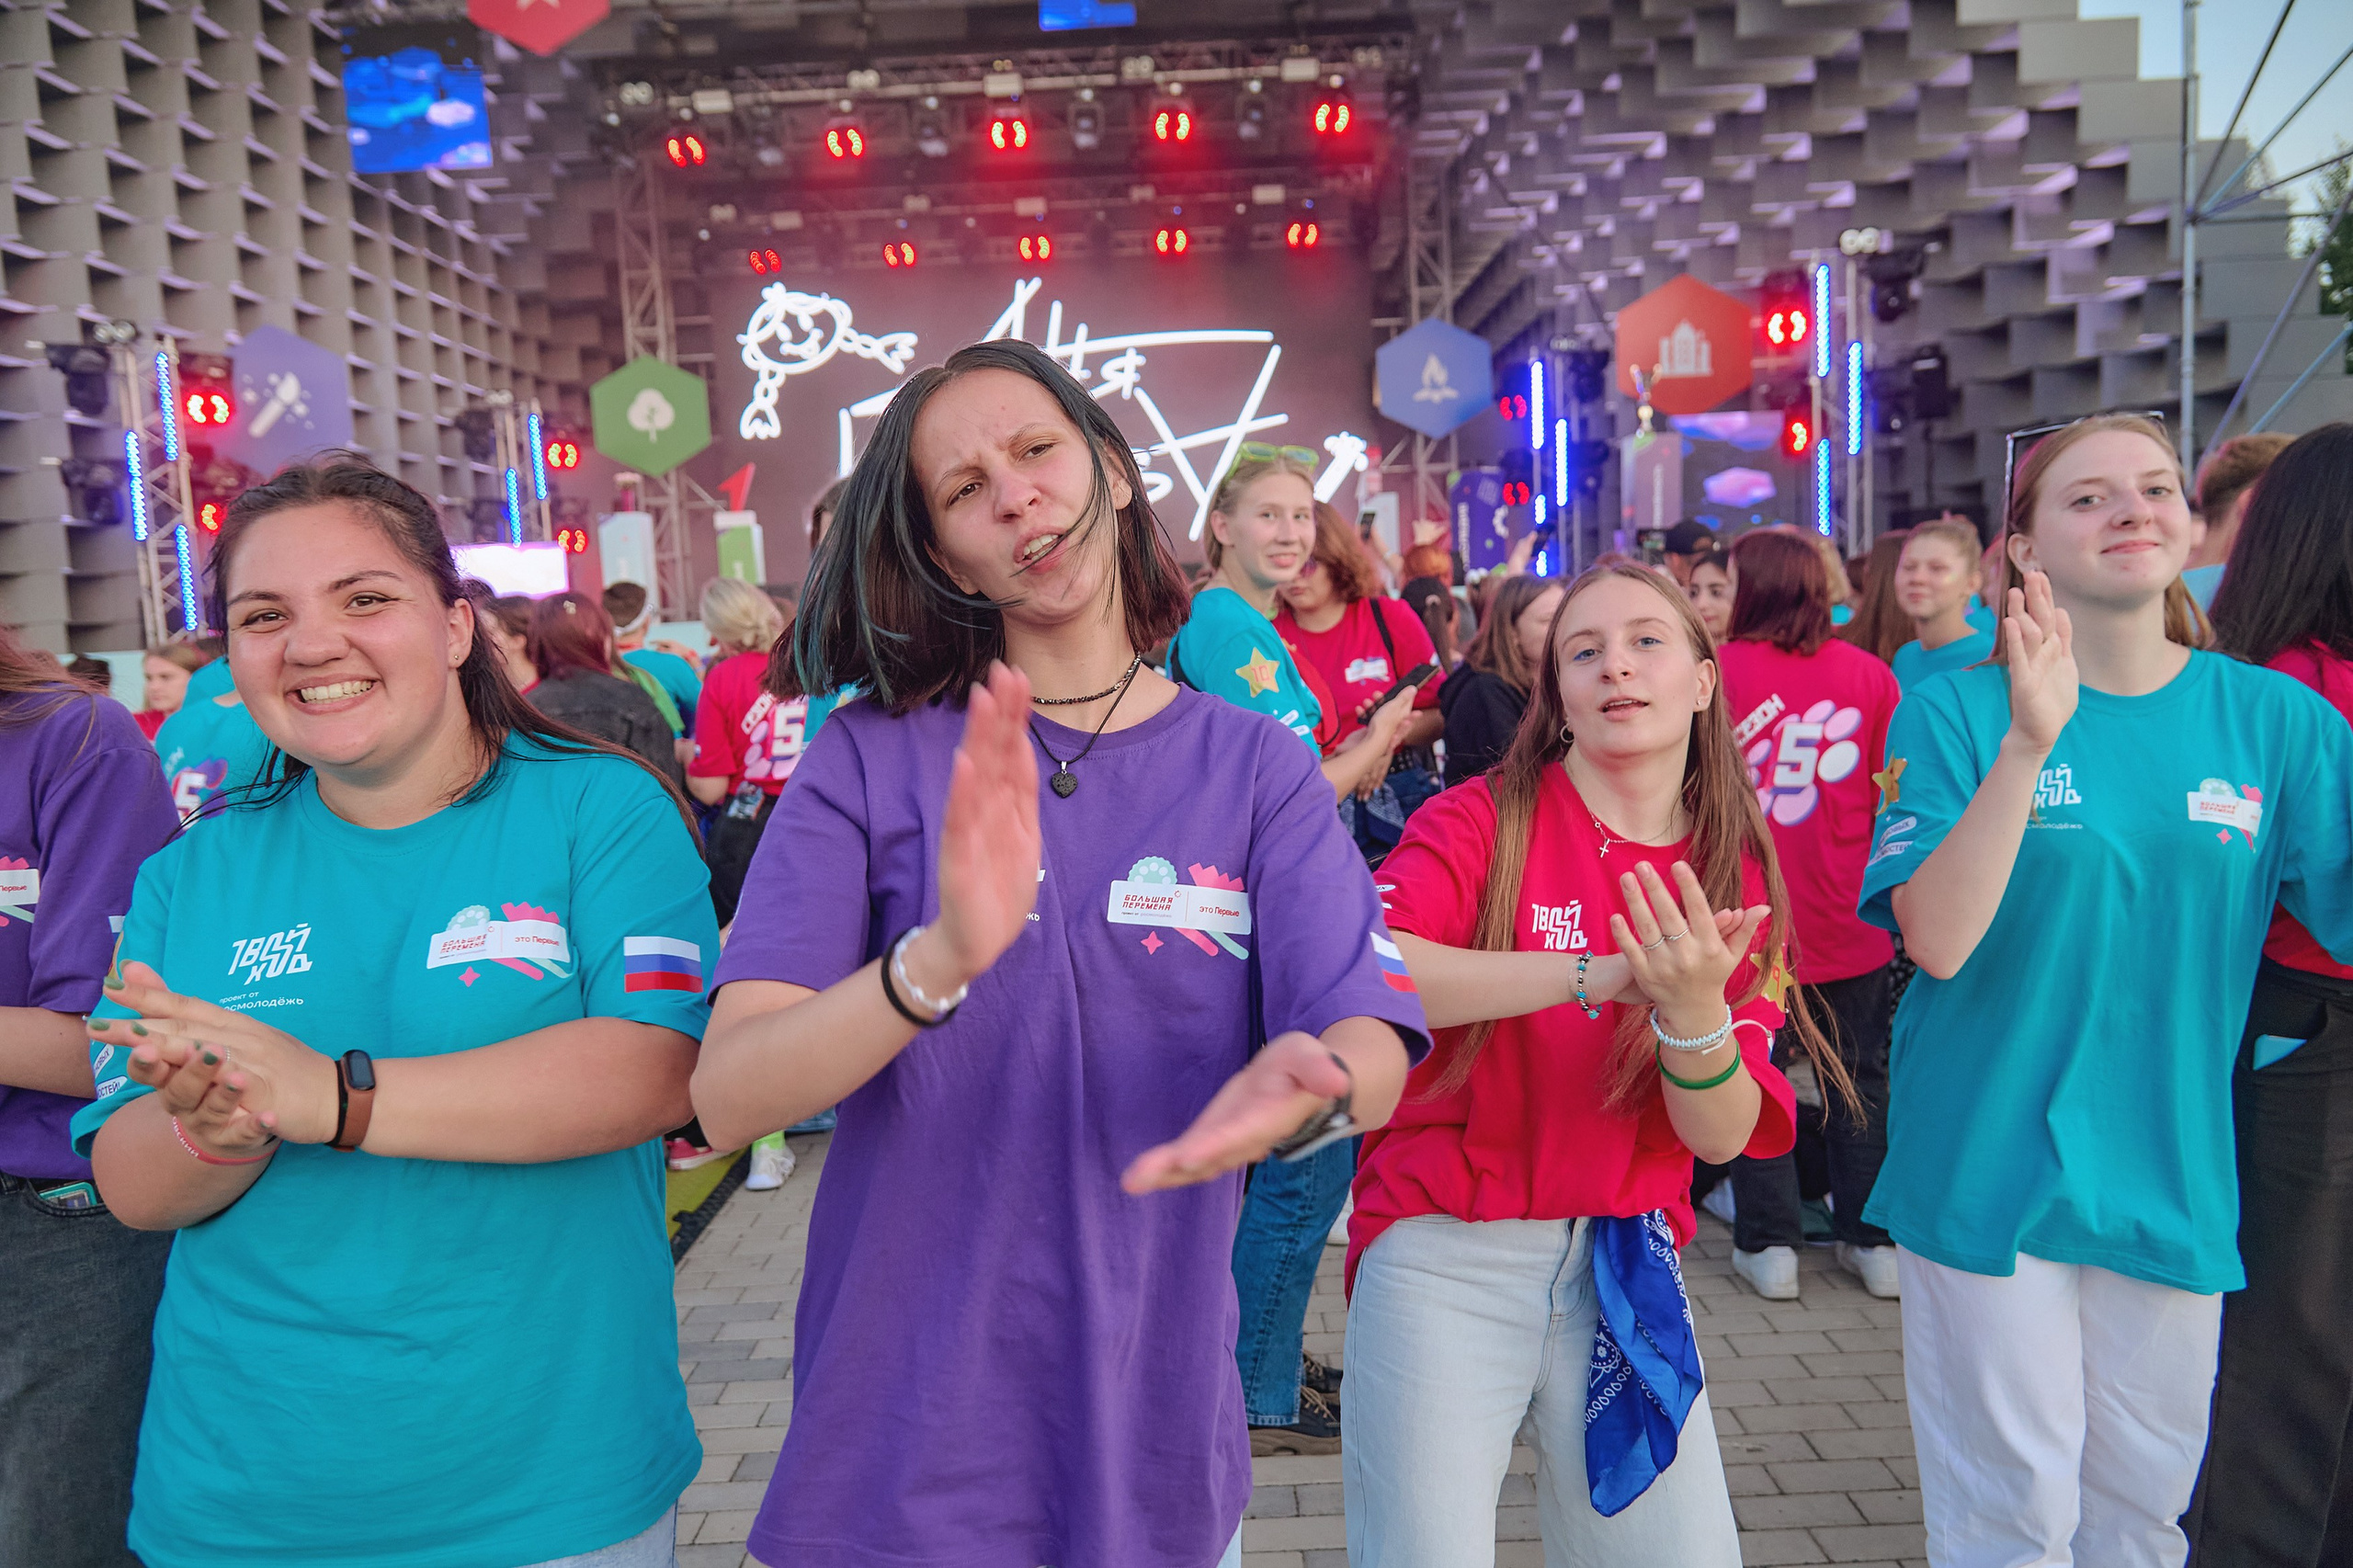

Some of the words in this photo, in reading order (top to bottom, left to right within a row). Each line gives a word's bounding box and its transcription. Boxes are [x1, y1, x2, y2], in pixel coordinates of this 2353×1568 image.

[771, 704, 806, 757] 5
[1772, 722, 1824, 790] 5
[1124, 894, 1174, 903] БОЛЬШАЯ
[1122, 901, 1172, 911] ПЕРЕМЕНА
[1199, 905, 1214, 915] это
[1214, 906, 1240, 917] Первые
[439, 940, 485, 954] ПЕРЕМЕНА
[442, 934, 487, 948] БОЛЬШАЯ
[219, 994, 246, 1004] проект
[223, 996, 304, 1012] осмолодёжь
